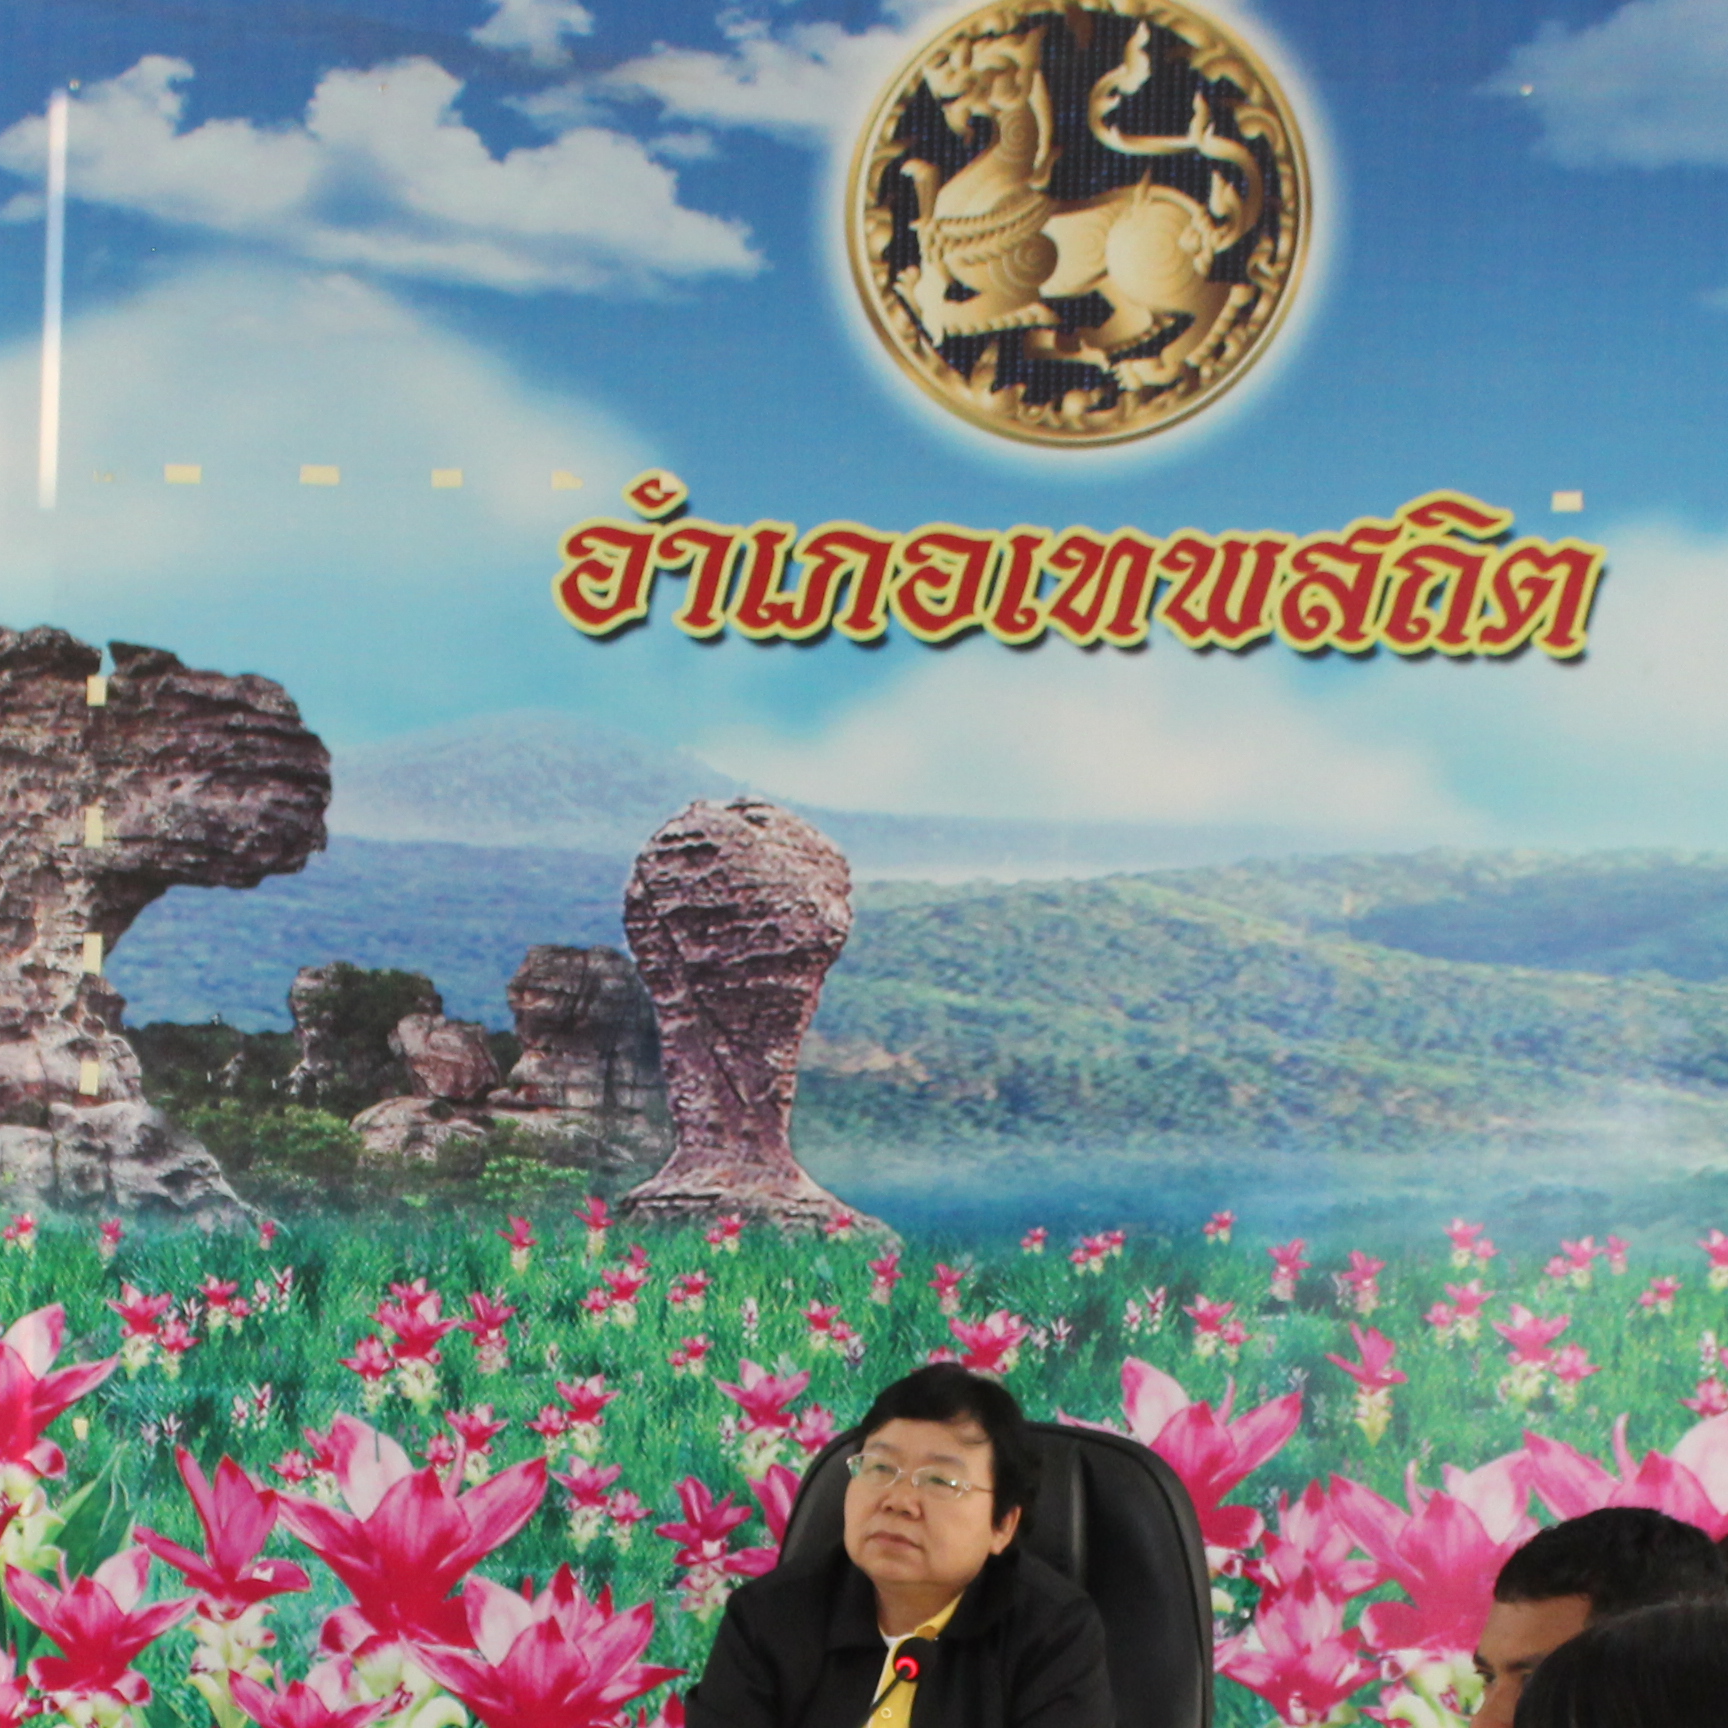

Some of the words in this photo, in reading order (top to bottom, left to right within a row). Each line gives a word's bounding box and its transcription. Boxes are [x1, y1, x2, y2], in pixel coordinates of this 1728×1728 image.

[551, 469, 1605, 659] อำเภอเทพสถิต
